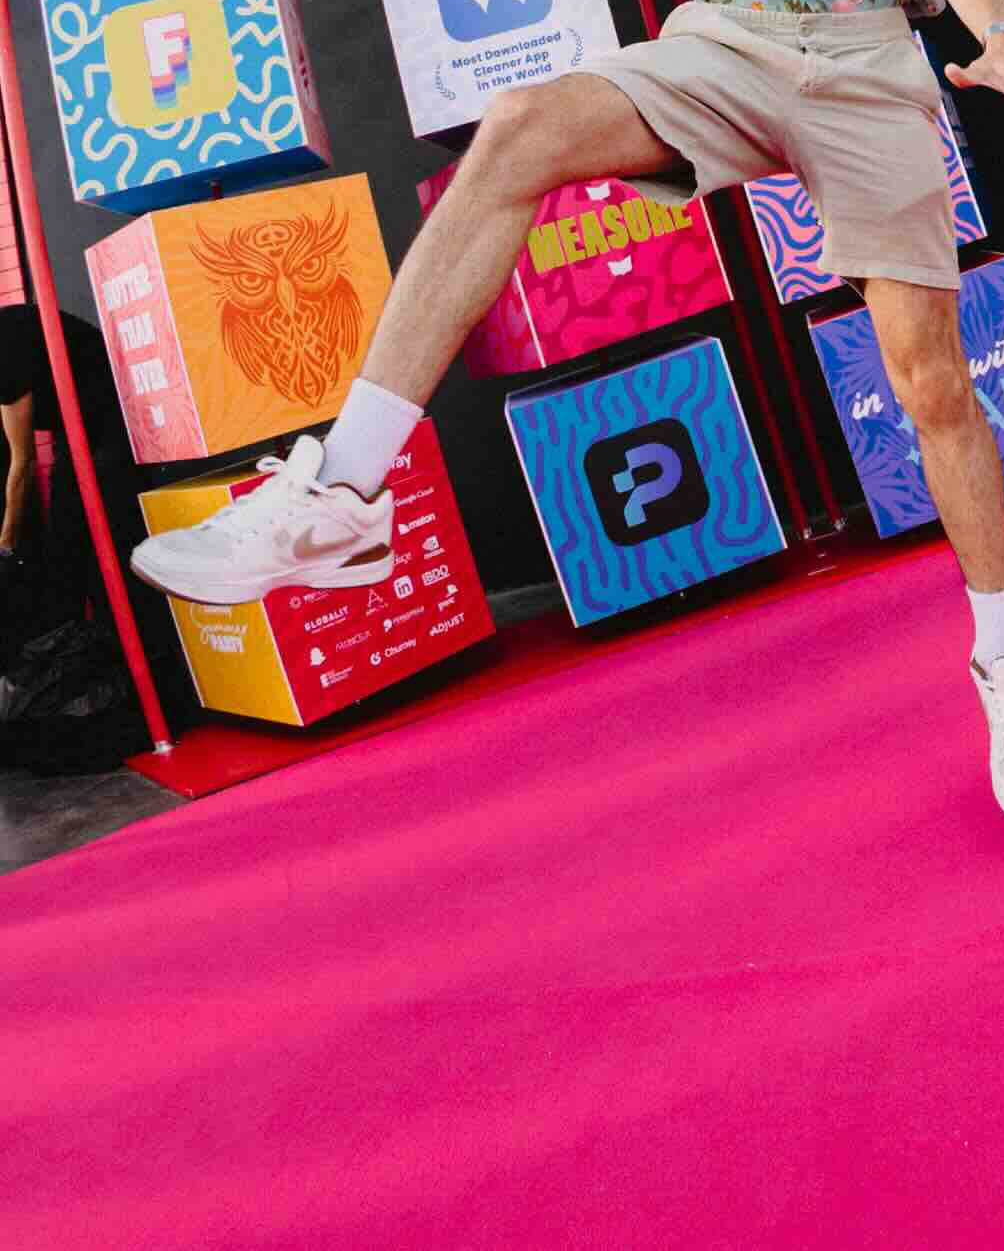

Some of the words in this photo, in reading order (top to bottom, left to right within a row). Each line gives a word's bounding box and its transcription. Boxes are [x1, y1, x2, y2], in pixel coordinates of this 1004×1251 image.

[452, 51, 482, 70] Most
[484, 31, 562, 61] Downloaded
[473, 59, 522, 78] Cleaner
[525, 49, 550, 66] App
[476, 80, 491, 92] in
[491, 74, 513, 87] the
[514, 63, 553, 81] World
[527, 198, 693, 275] MEASURE
[852, 391, 885, 421] in
